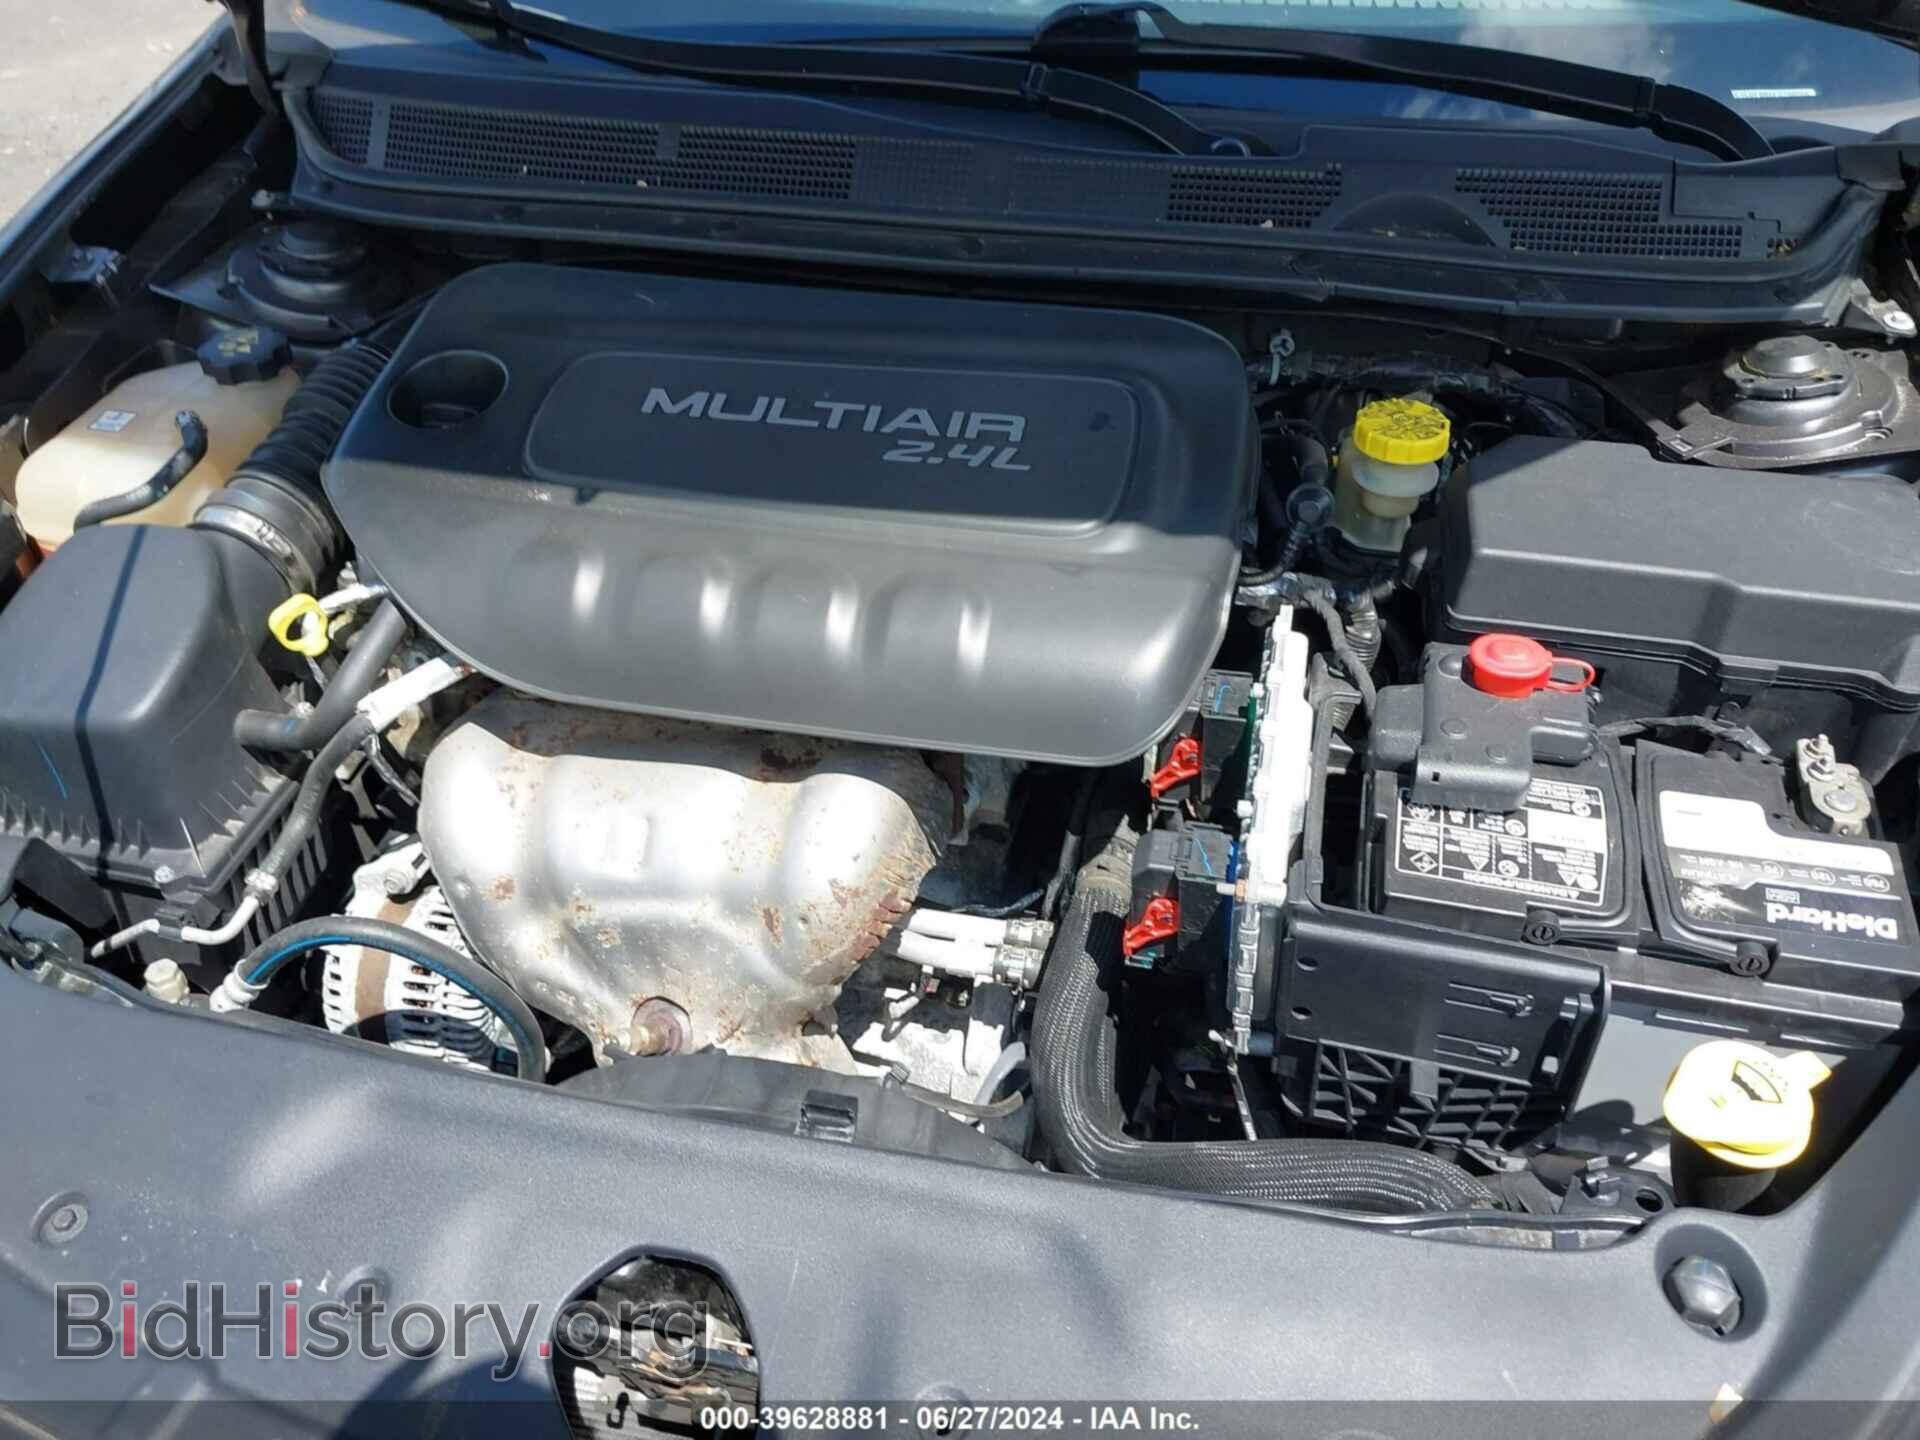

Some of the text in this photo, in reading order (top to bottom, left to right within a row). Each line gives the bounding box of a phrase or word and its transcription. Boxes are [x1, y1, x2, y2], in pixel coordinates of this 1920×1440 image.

[640, 386, 1027, 442] MULTIAIR
[881, 439, 1032, 471] 2.4L
[1766, 902, 1898, 940] DieHard
